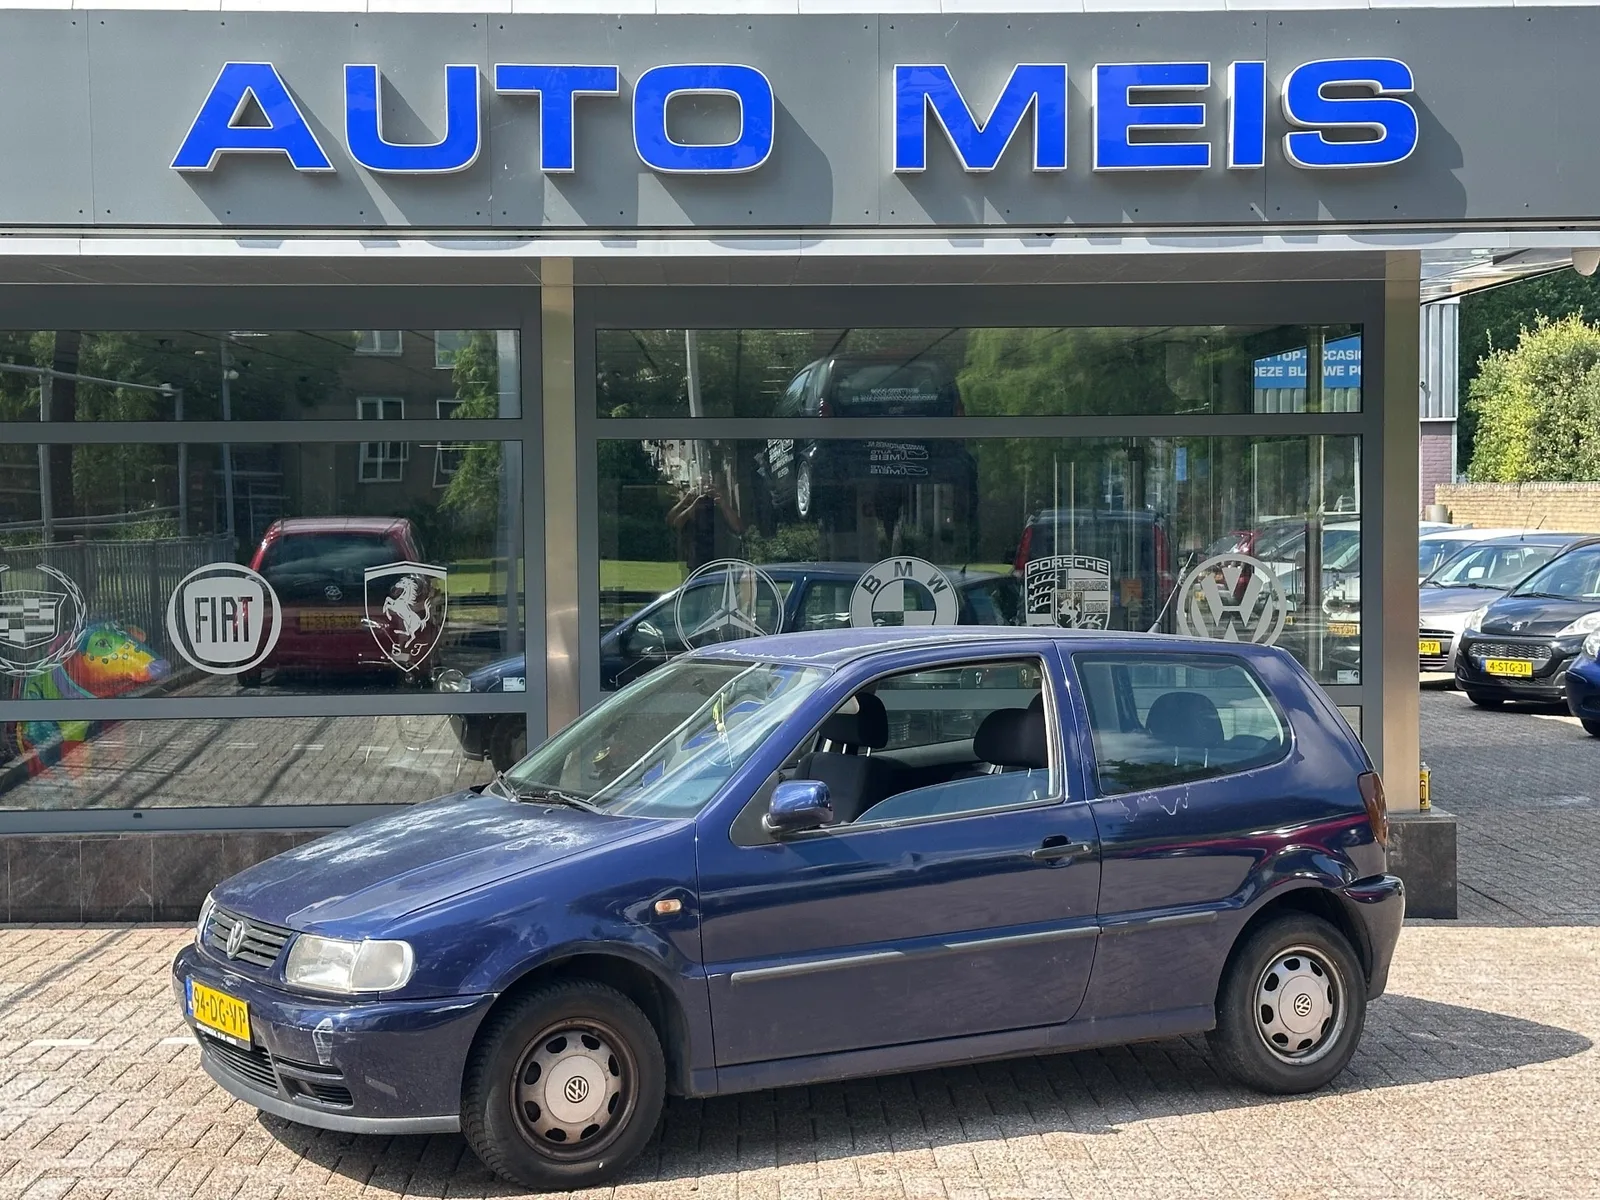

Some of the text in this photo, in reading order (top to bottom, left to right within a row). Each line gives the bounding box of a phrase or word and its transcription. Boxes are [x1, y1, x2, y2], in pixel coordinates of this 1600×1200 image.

[169, 57, 1420, 175] AUTO MEIS
[861, 561, 948, 595] BMW
[1028, 558, 1108, 575] PORSCHE
[194, 597, 253, 643] FIAT
[1489, 662, 1528, 673] 4-STG-31
